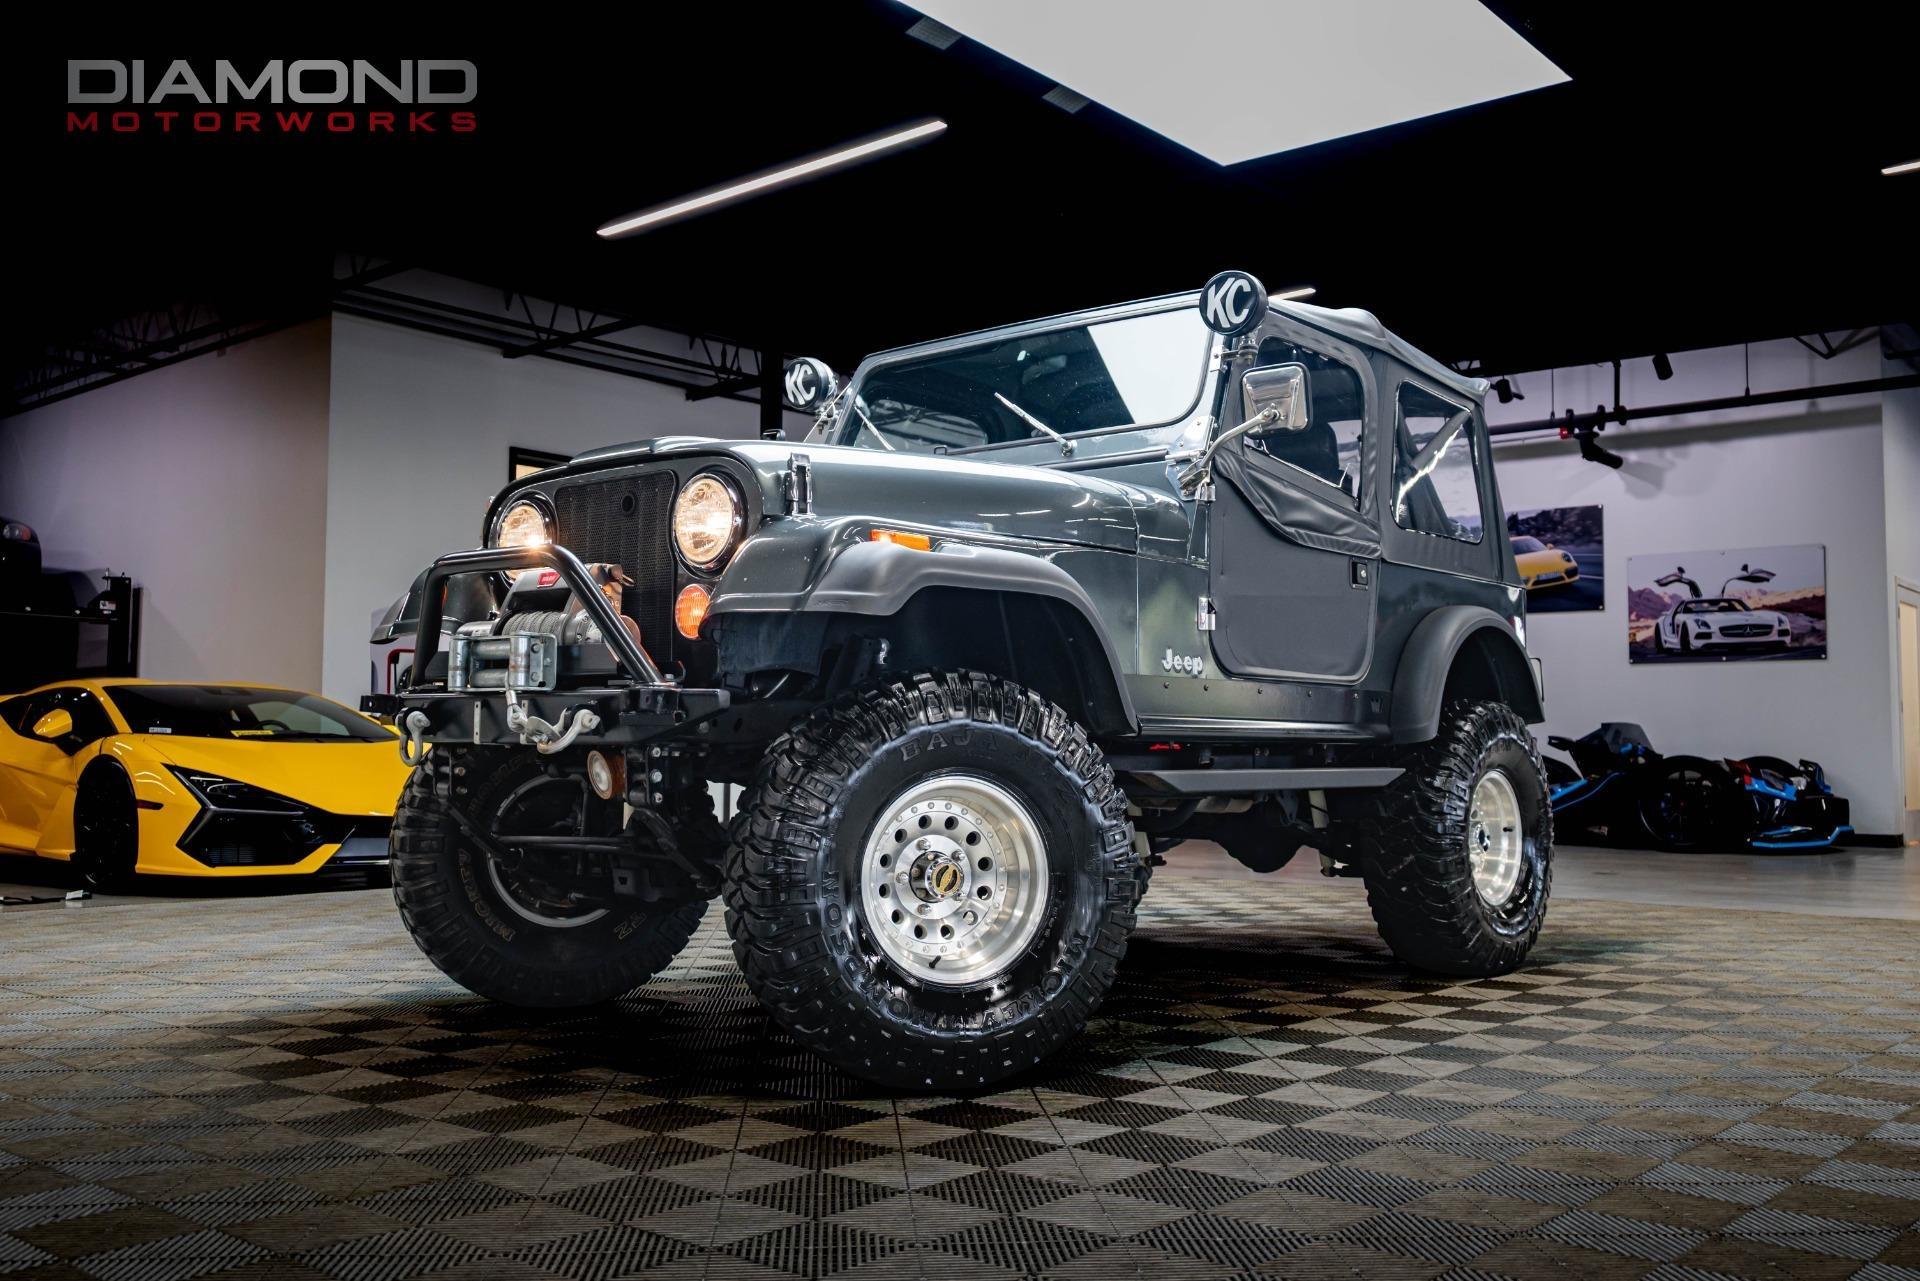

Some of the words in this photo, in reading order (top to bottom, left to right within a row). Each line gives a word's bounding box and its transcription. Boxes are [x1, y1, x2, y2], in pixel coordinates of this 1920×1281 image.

[1206, 277, 1252, 329] KC
[785, 363, 816, 406] KC
[1160, 647, 1204, 677] Jeep
[899, 728, 999, 763] BAJA
[821, 871, 962, 1029] OMPSON
